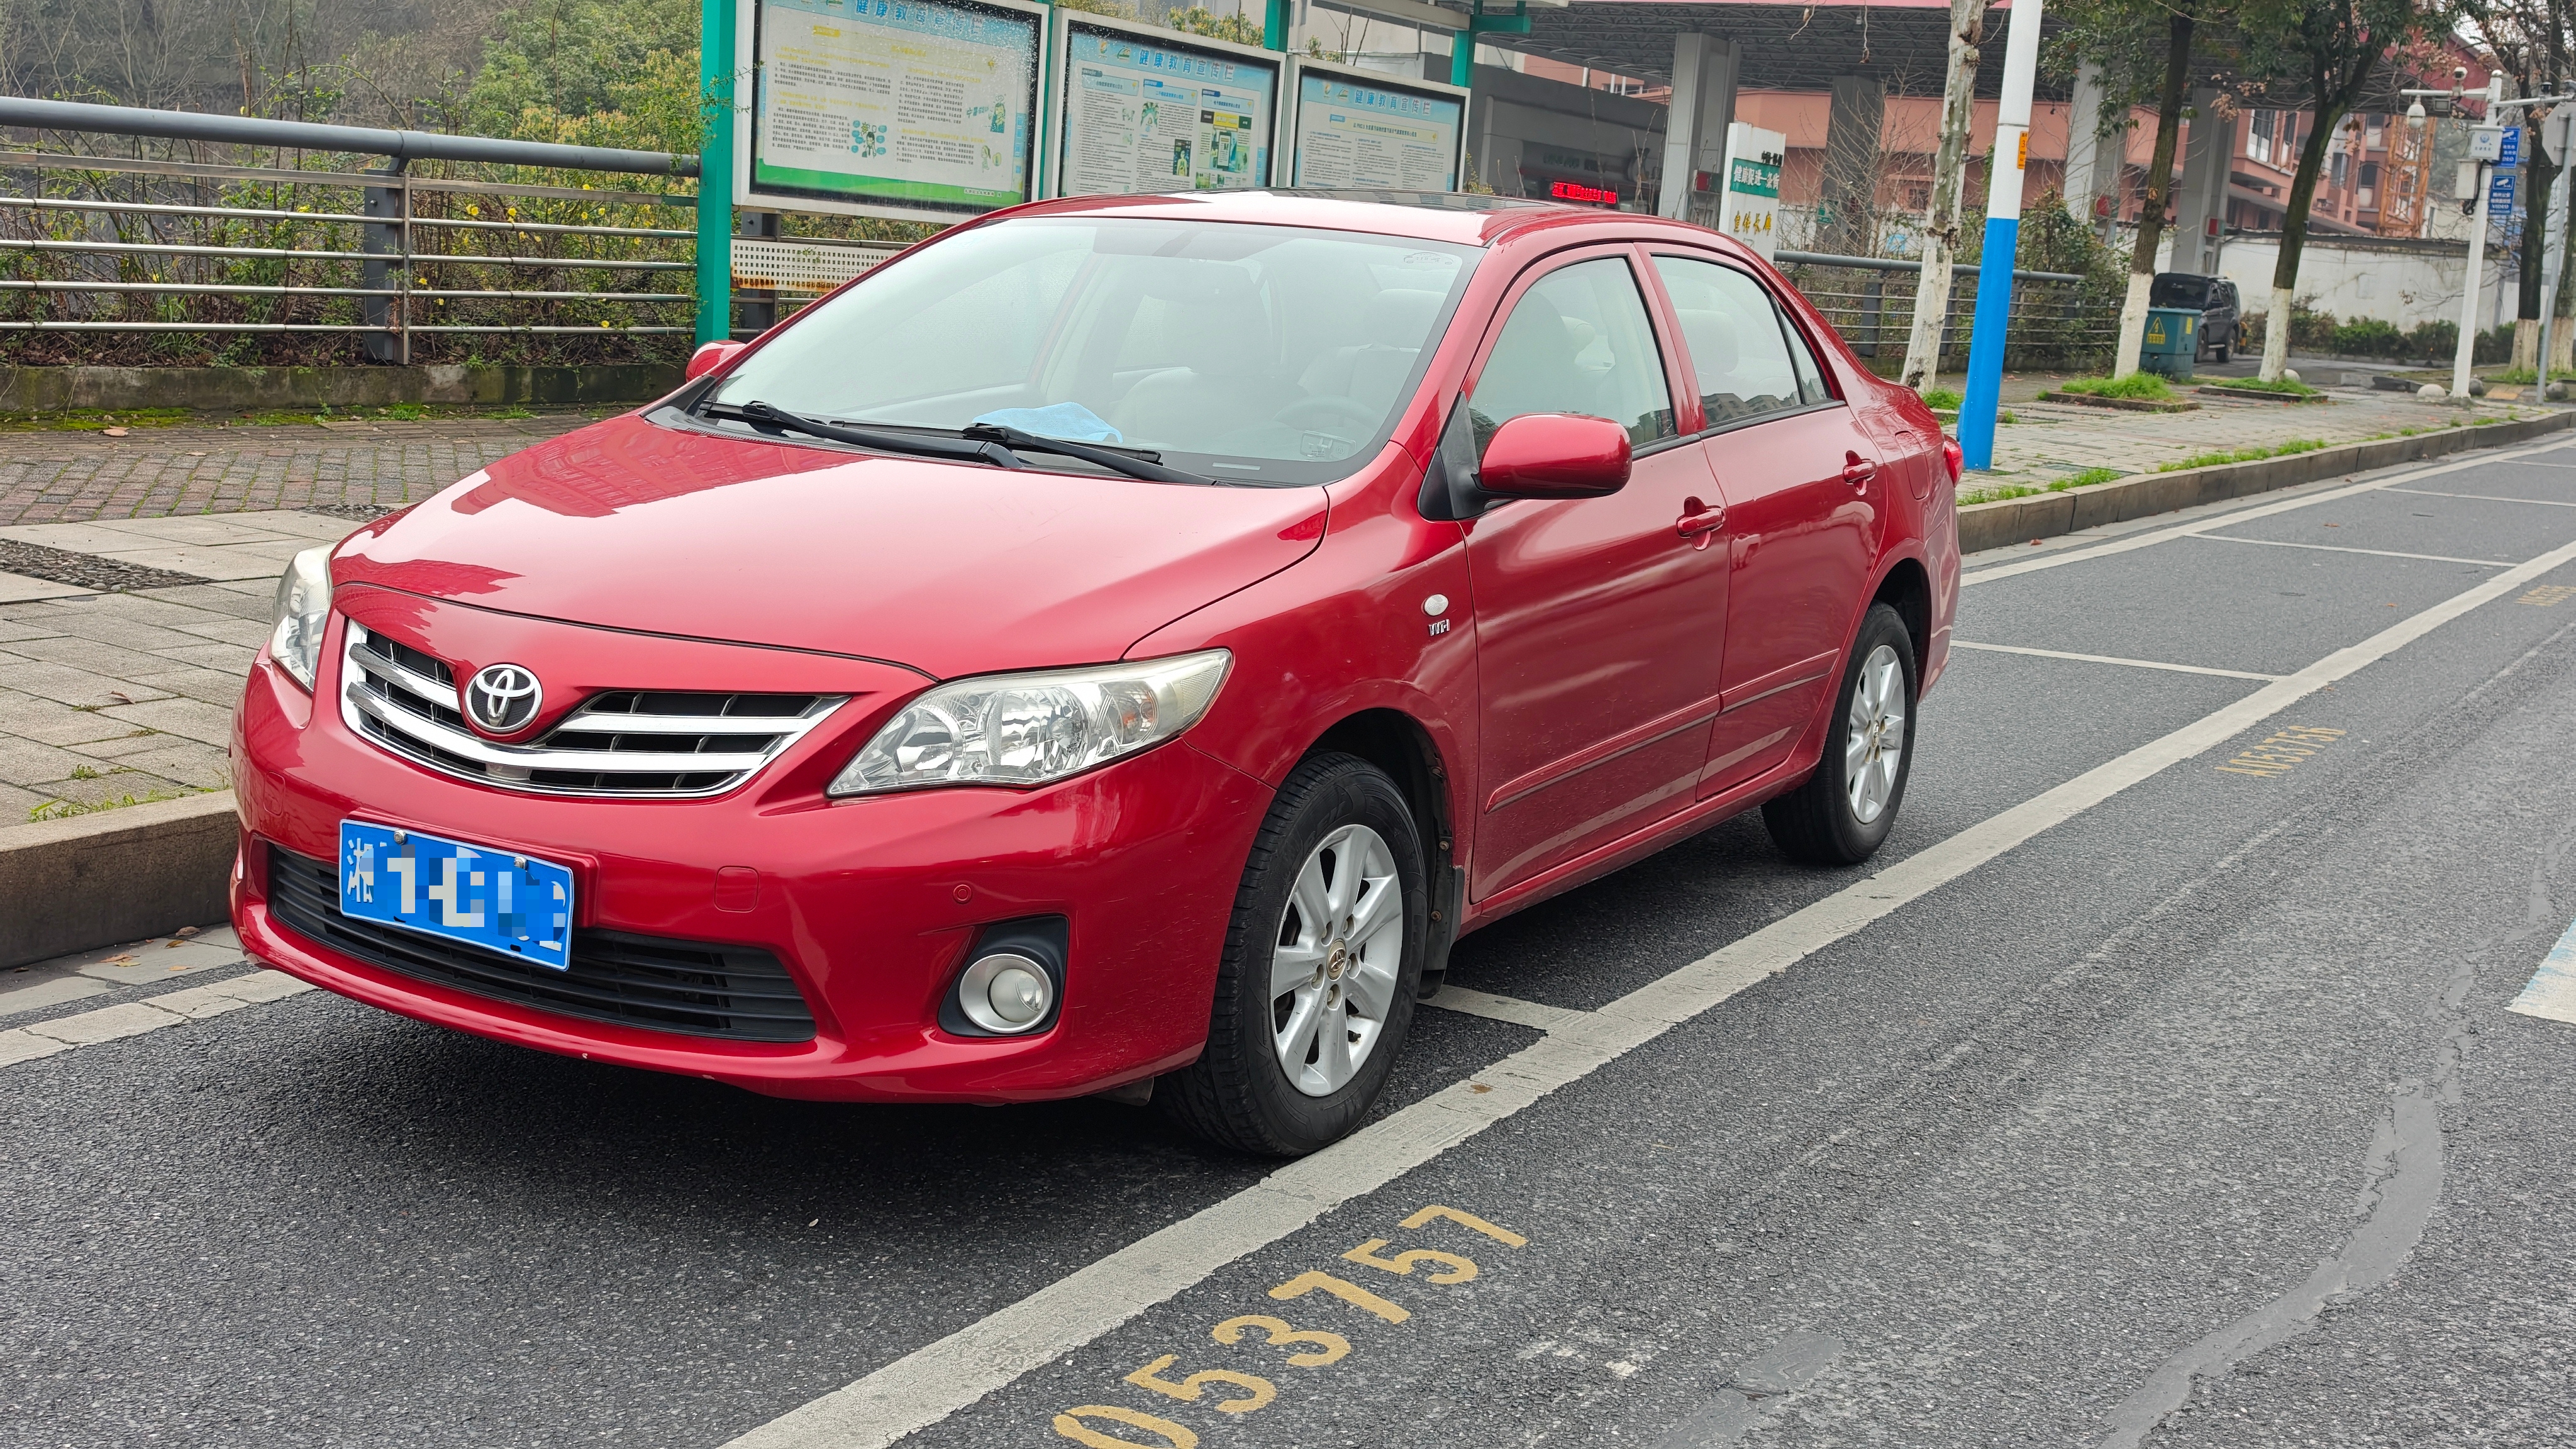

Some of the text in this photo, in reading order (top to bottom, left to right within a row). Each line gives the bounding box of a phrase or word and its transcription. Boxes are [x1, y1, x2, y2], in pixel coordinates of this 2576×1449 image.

[1139, 48, 1234, 80] 健康教育宣传栏
[1355, 89, 1431, 115] 健康教育宣传栏
[1733, 164, 1780, 191] 健康促进一条街
[2214, 725, 2347, 779] A053756
[1052, 1204, 1528, 1449] 053757
